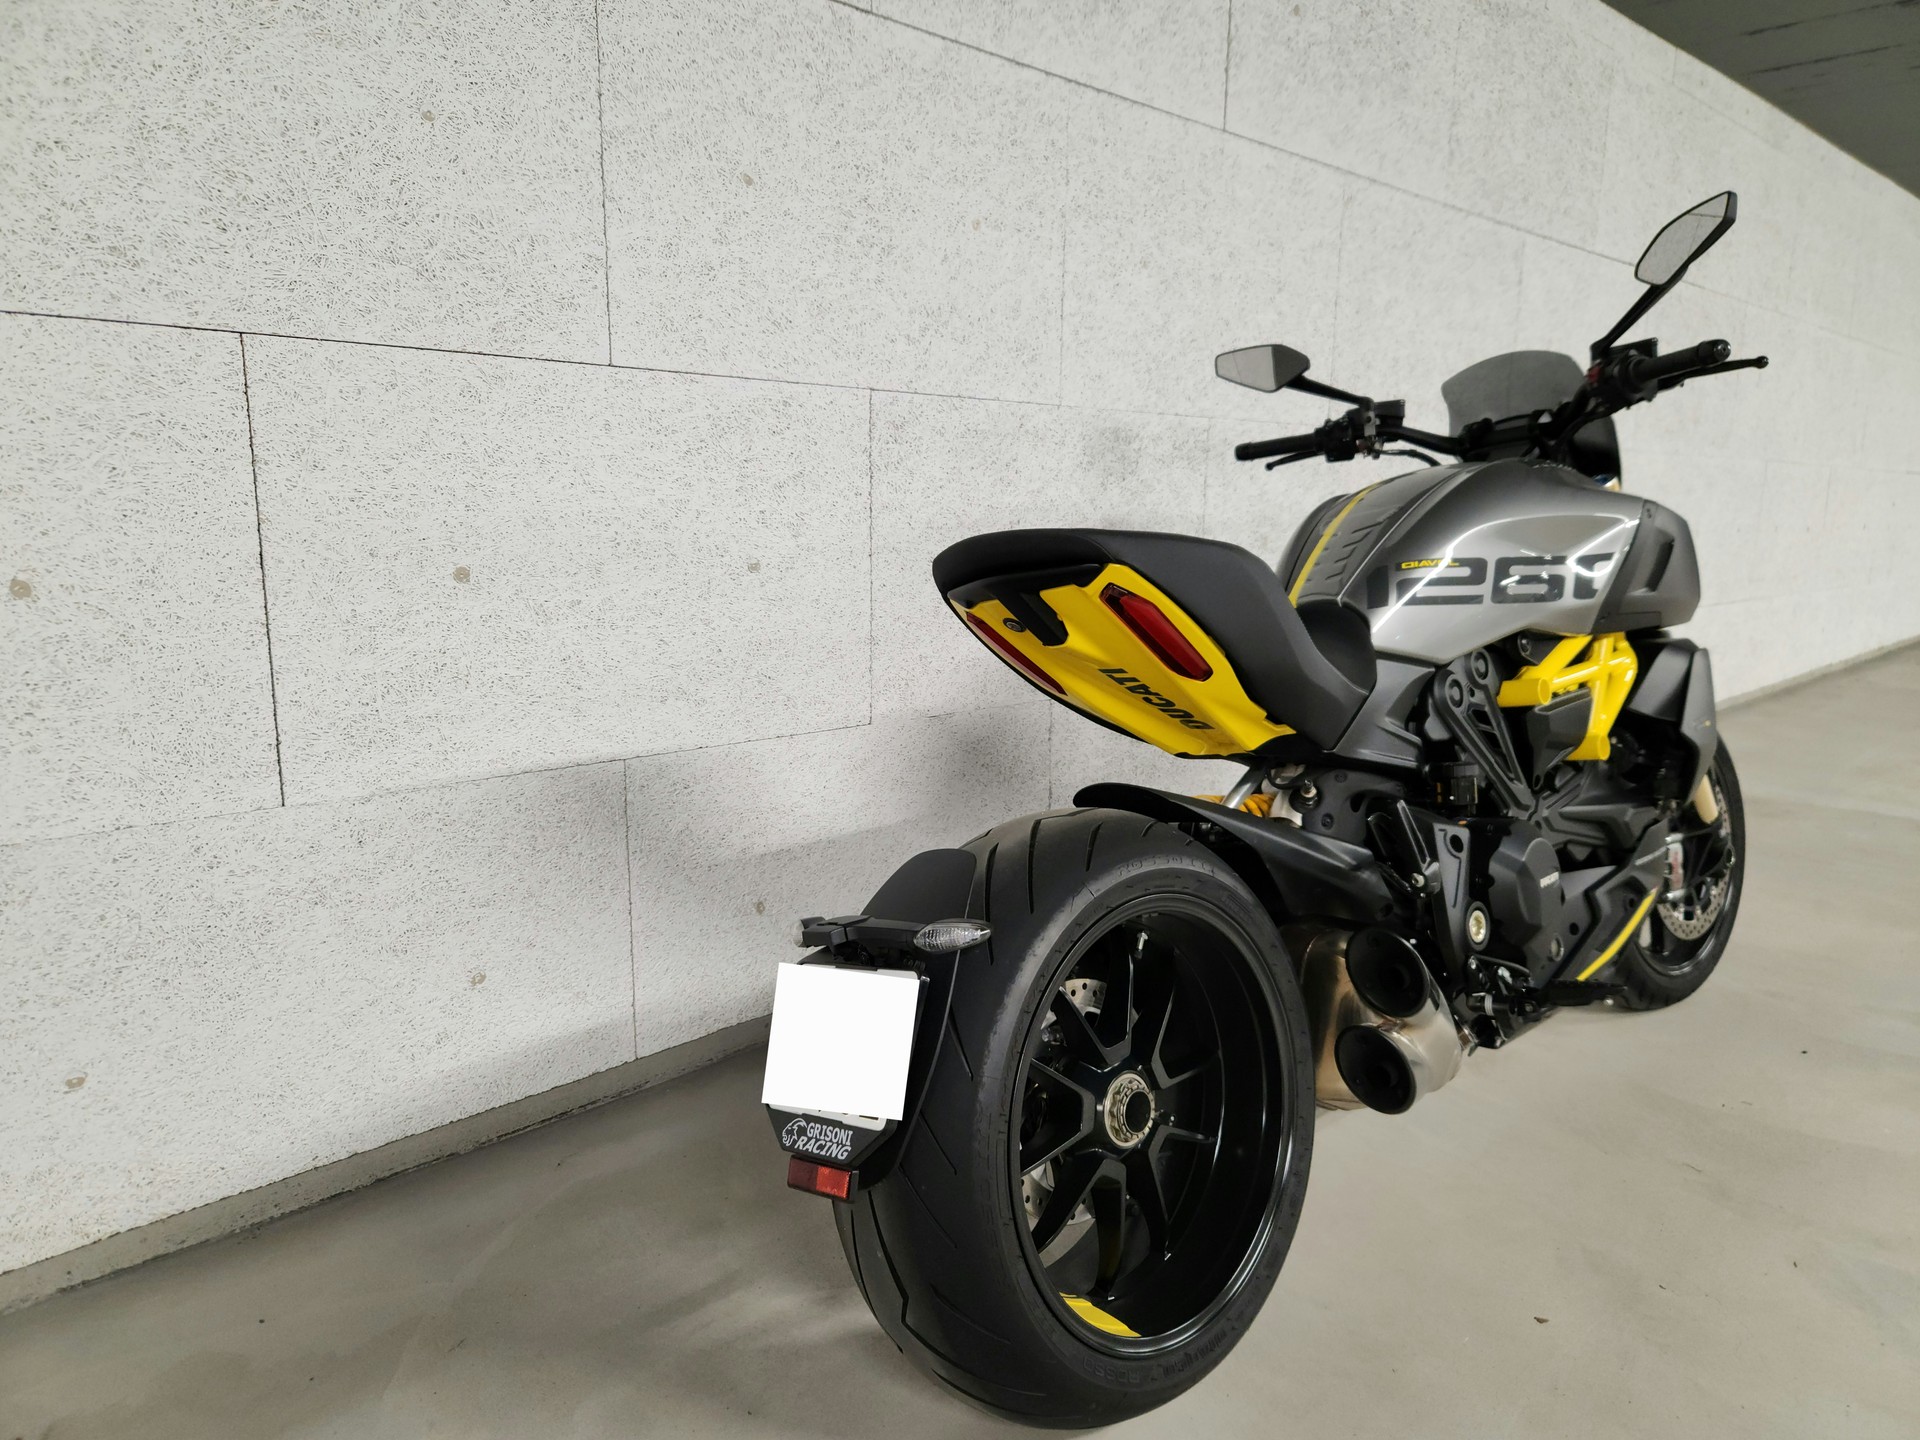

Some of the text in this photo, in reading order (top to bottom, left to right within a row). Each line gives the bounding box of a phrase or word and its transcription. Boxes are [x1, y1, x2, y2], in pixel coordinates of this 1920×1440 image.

[1401, 559, 1460, 570] DIAVL
[1098, 668, 1216, 731] DUCATI
[806, 1122, 853, 1146] GRISONI
[794, 1136, 852, 1160] RACING
